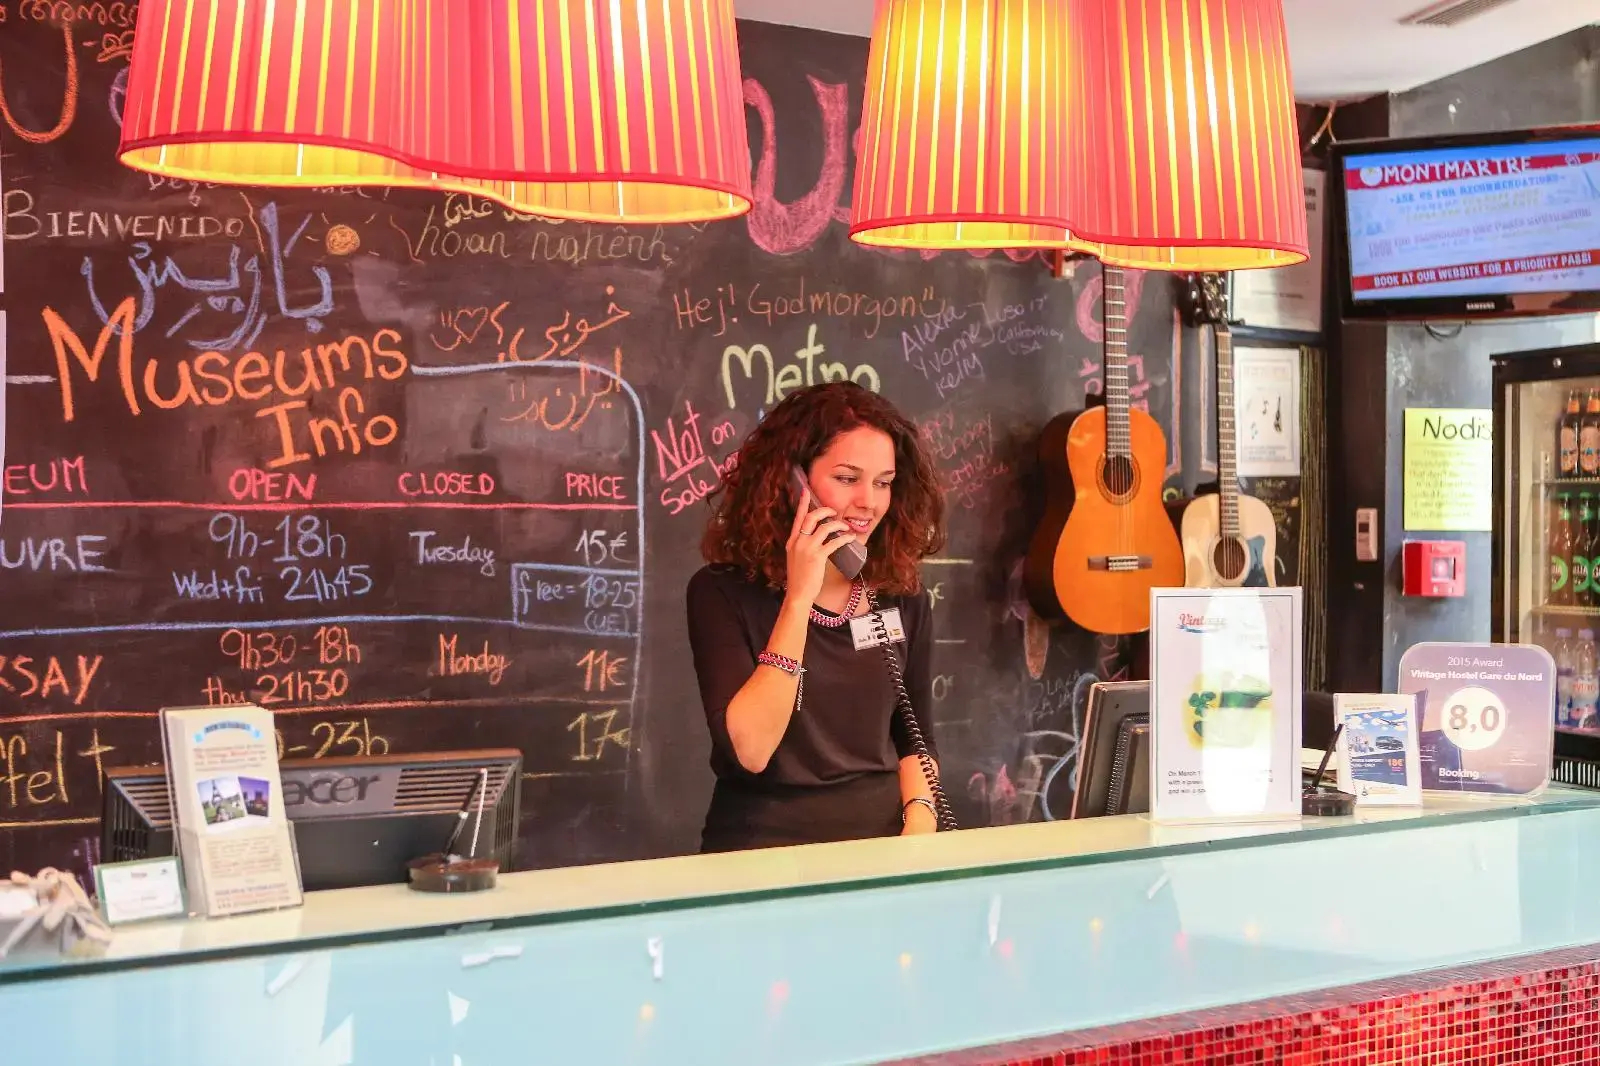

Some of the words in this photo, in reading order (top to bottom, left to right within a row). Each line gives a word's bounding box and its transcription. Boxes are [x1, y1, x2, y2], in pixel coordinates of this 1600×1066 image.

[1384, 156, 1531, 183] MONTMARTRE
[3, 189, 244, 240] BIENVENIDO
[1373, 274, 1399, 288] BOOK
[1401, 273, 1415, 285] AT
[1417, 271, 1436, 283] OUR
[1439, 267, 1480, 282] WEBSITE
[1483, 264, 1502, 276] FOR
[1505, 263, 1512, 273] A
[1514, 256, 1560, 271] PRIORITY
[672, 284, 738, 337] Hej!
[1466, 302, 1496, 310] SAMSUNG
[42, 296, 408, 422] Museums
[256, 386, 398, 468] Info
[651, 400, 704, 481] Not
[711, 420, 737, 447] on
[228, 468, 318, 501] OPEN
[399, 471, 496, 497] CLOSED
[565, 471, 628, 500] PRICE
[208, 512, 347, 563] 9h-18h
[409, 530, 496, 578] Tuesday
[575, 529, 637, 566] 15€
[279, 565, 374, 603] 21h45
[220, 625, 362, 671] 9h30-18h
[439, 633, 511, 686] Monday
[576, 650, 629, 692] 11€
[1410, 669, 1447, 681] Vintage
[1448, 670, 1478, 681] Hostel
[1479, 671, 1501, 681] Gare
[1504, 672, 1517, 681] du
[1518, 672, 1544, 682] Nord
[1447, 656, 1471, 667] 2015
[1472, 657, 1504, 668] Award
[257, 668, 349, 704] 21h30
[1447, 704, 1500, 733] 8,0
[282, 775, 380, 806] acer
